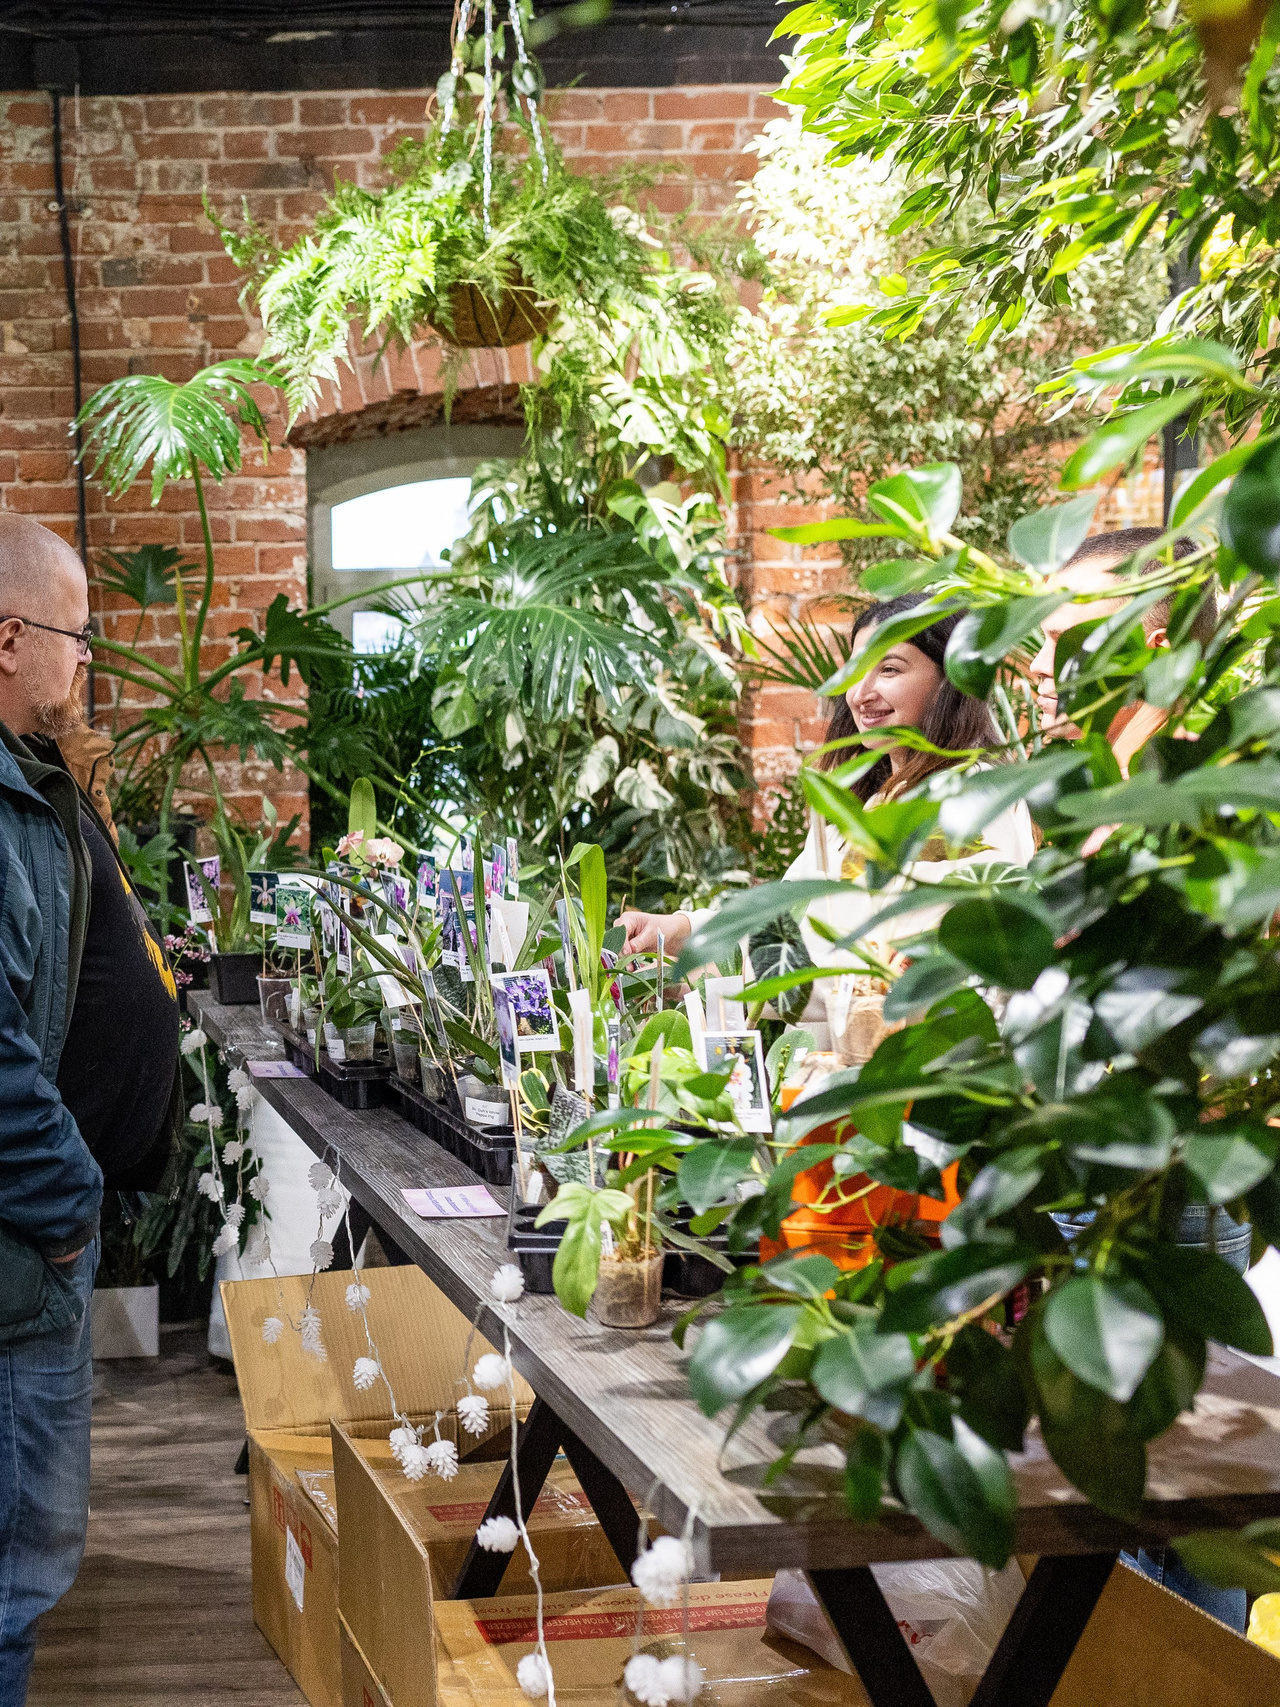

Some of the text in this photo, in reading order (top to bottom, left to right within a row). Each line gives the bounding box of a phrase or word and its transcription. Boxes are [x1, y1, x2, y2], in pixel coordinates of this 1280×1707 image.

[715, 1591, 768, 1600] Please
[593, 1598, 649, 1608] xpose
[731, 1605, 767, 1615] TORAGE
[582, 1616, 610, 1625] FROM
[640, 1613, 662, 1621] KEE
[485, 1621, 529, 1631] FREEZER
[545, 1618, 581, 1627] HEATER
